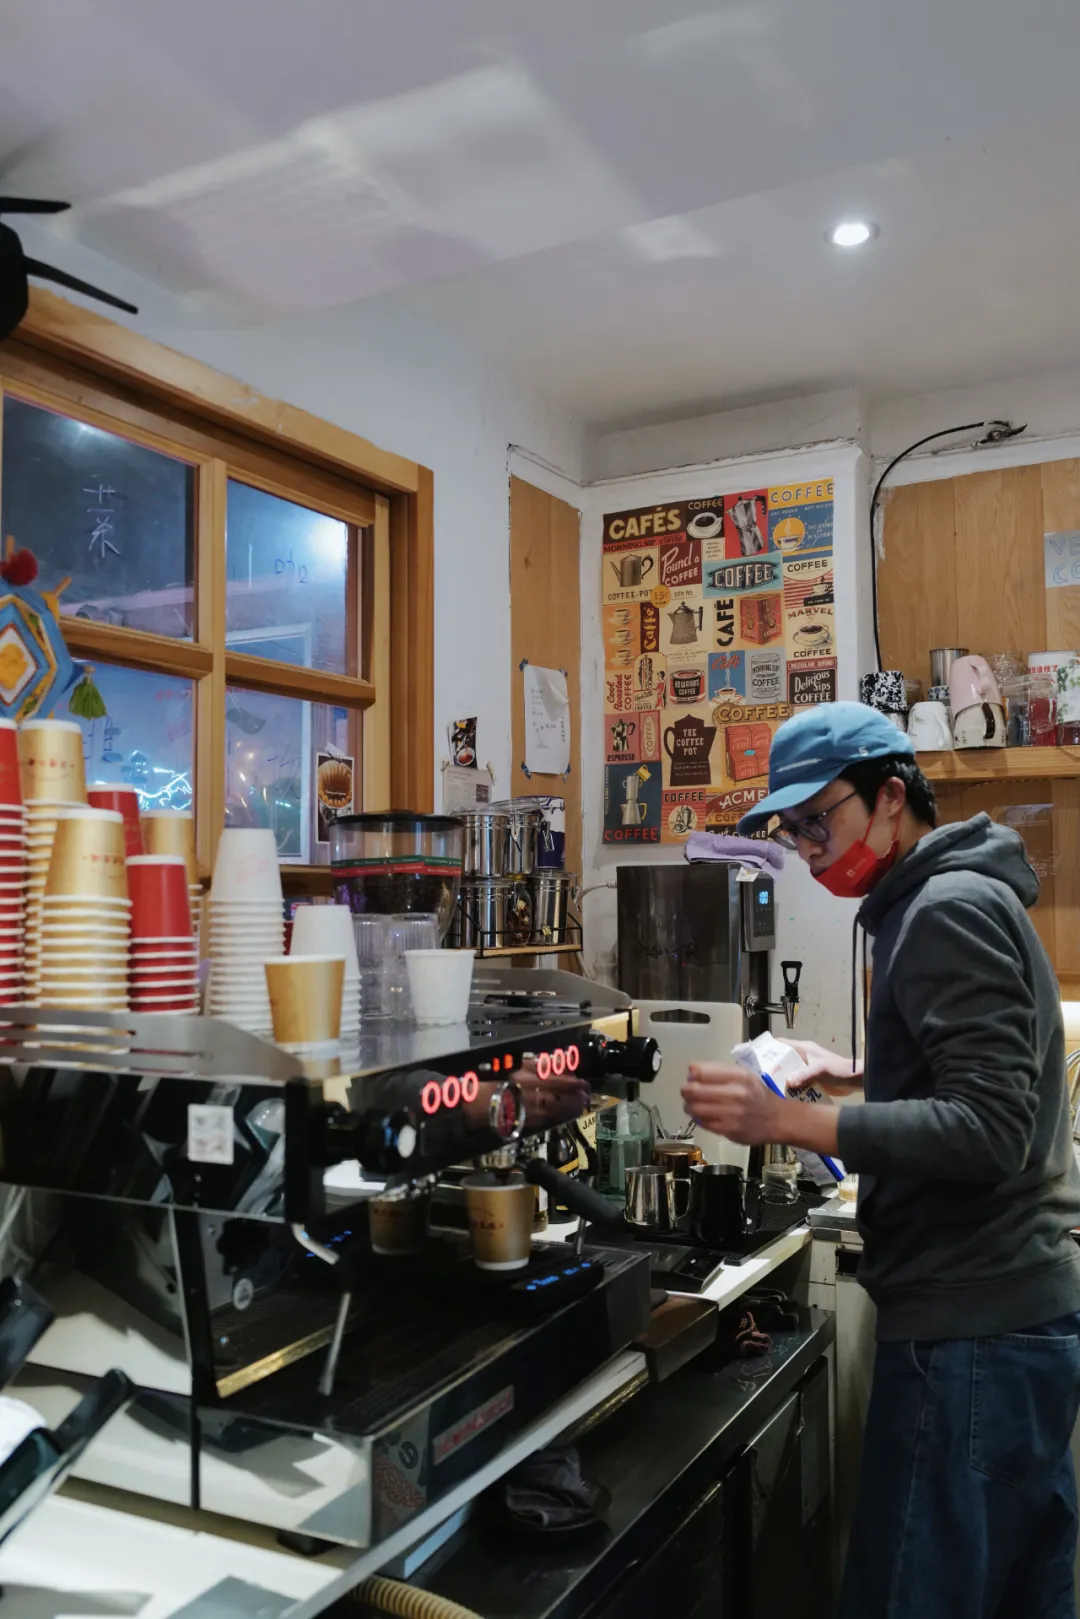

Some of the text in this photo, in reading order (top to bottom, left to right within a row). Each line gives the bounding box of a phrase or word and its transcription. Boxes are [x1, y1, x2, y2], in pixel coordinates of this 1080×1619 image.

[770, 483, 834, 503] COFFEE
[687, 499, 723, 510] COFFEE
[608, 507, 682, 540] CAFÉS
[603, 541, 642, 553] MORNING
[643, 539, 657, 548] SIP
[661, 542, 693, 583] Pound
[787, 559, 828, 573] COFFEE
[665, 567, 698, 587] COFFEE
[714, 563, 773, 588] COFFEE
[787, 607, 833, 619] MARVEL
[793, 648, 832, 658] COFFEE
[752, 676, 780, 687] COFFEE
[794, 671, 831, 693] Delicious
[812, 682, 832, 692] Sips
[624, 674, 632, 710] COFFEE
[678, 687, 696, 696] COFFEE
[794, 692, 832, 703] COFFEE
[717, 703, 790, 721] COFFEE
[645, 721, 654, 752] COFFEE
[682, 728, 697, 737] THE
[676, 737, 705, 747] COFFEE
[683, 747, 698, 756] POT
[663, 791, 705, 803] COFFEE
[719, 789, 767, 810] ACME
[604, 827, 658, 841] COFFEE
